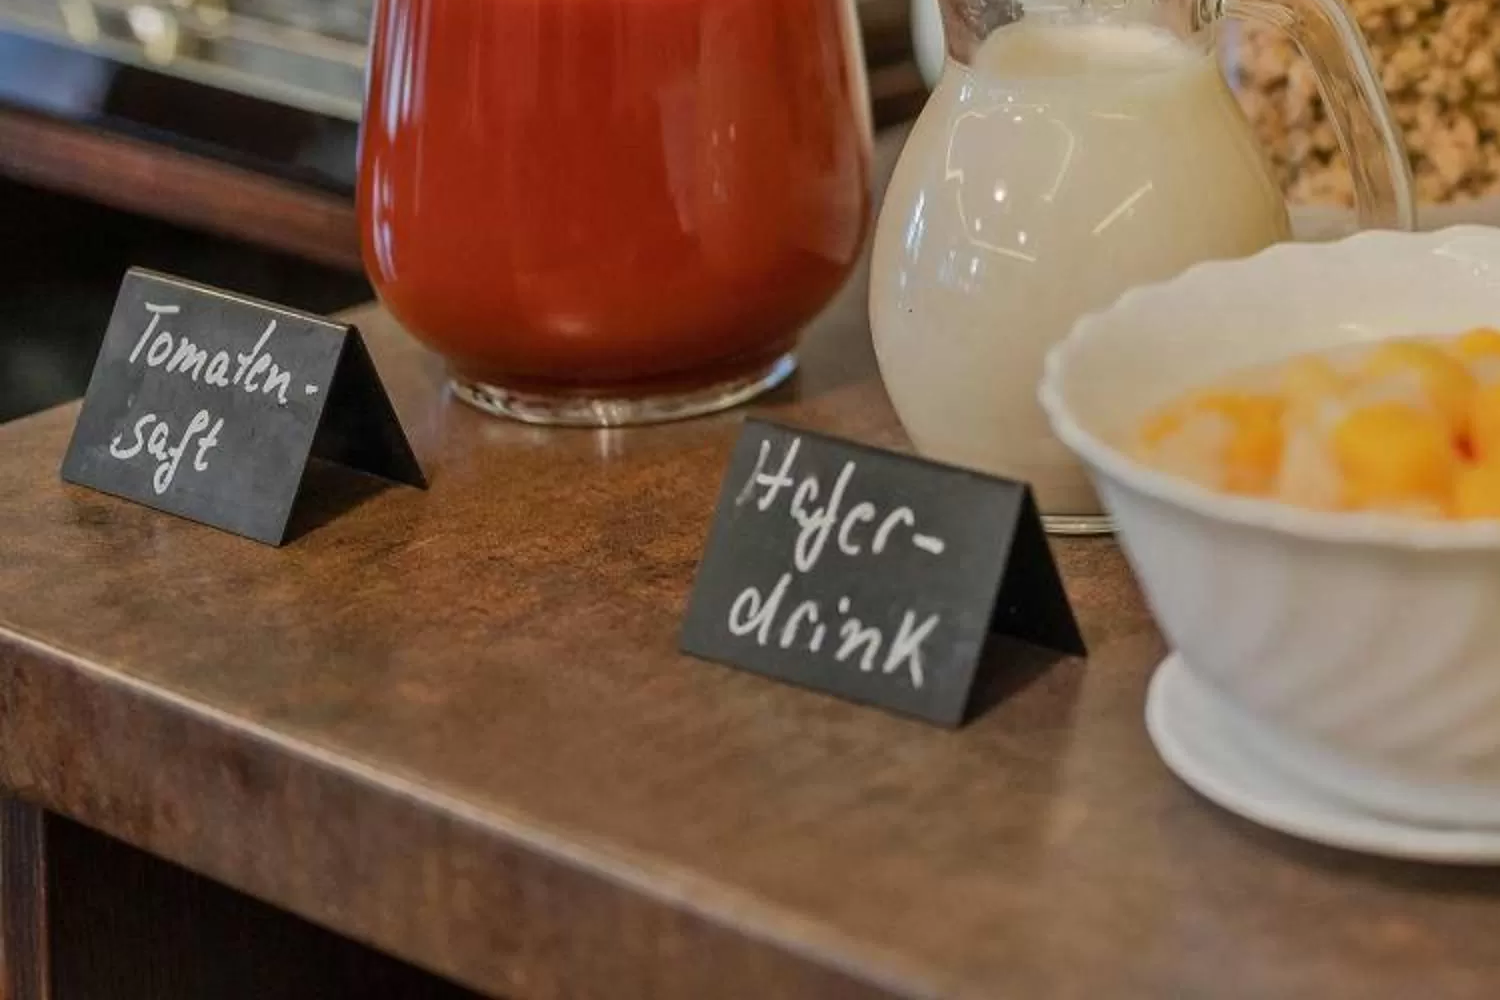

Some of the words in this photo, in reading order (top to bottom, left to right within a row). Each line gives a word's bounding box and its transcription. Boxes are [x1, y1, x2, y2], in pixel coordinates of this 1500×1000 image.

[128, 301, 319, 404] Tomaten-
[109, 409, 225, 496] saft
[735, 435, 946, 573] Hafer-
[727, 572, 941, 689] drink
